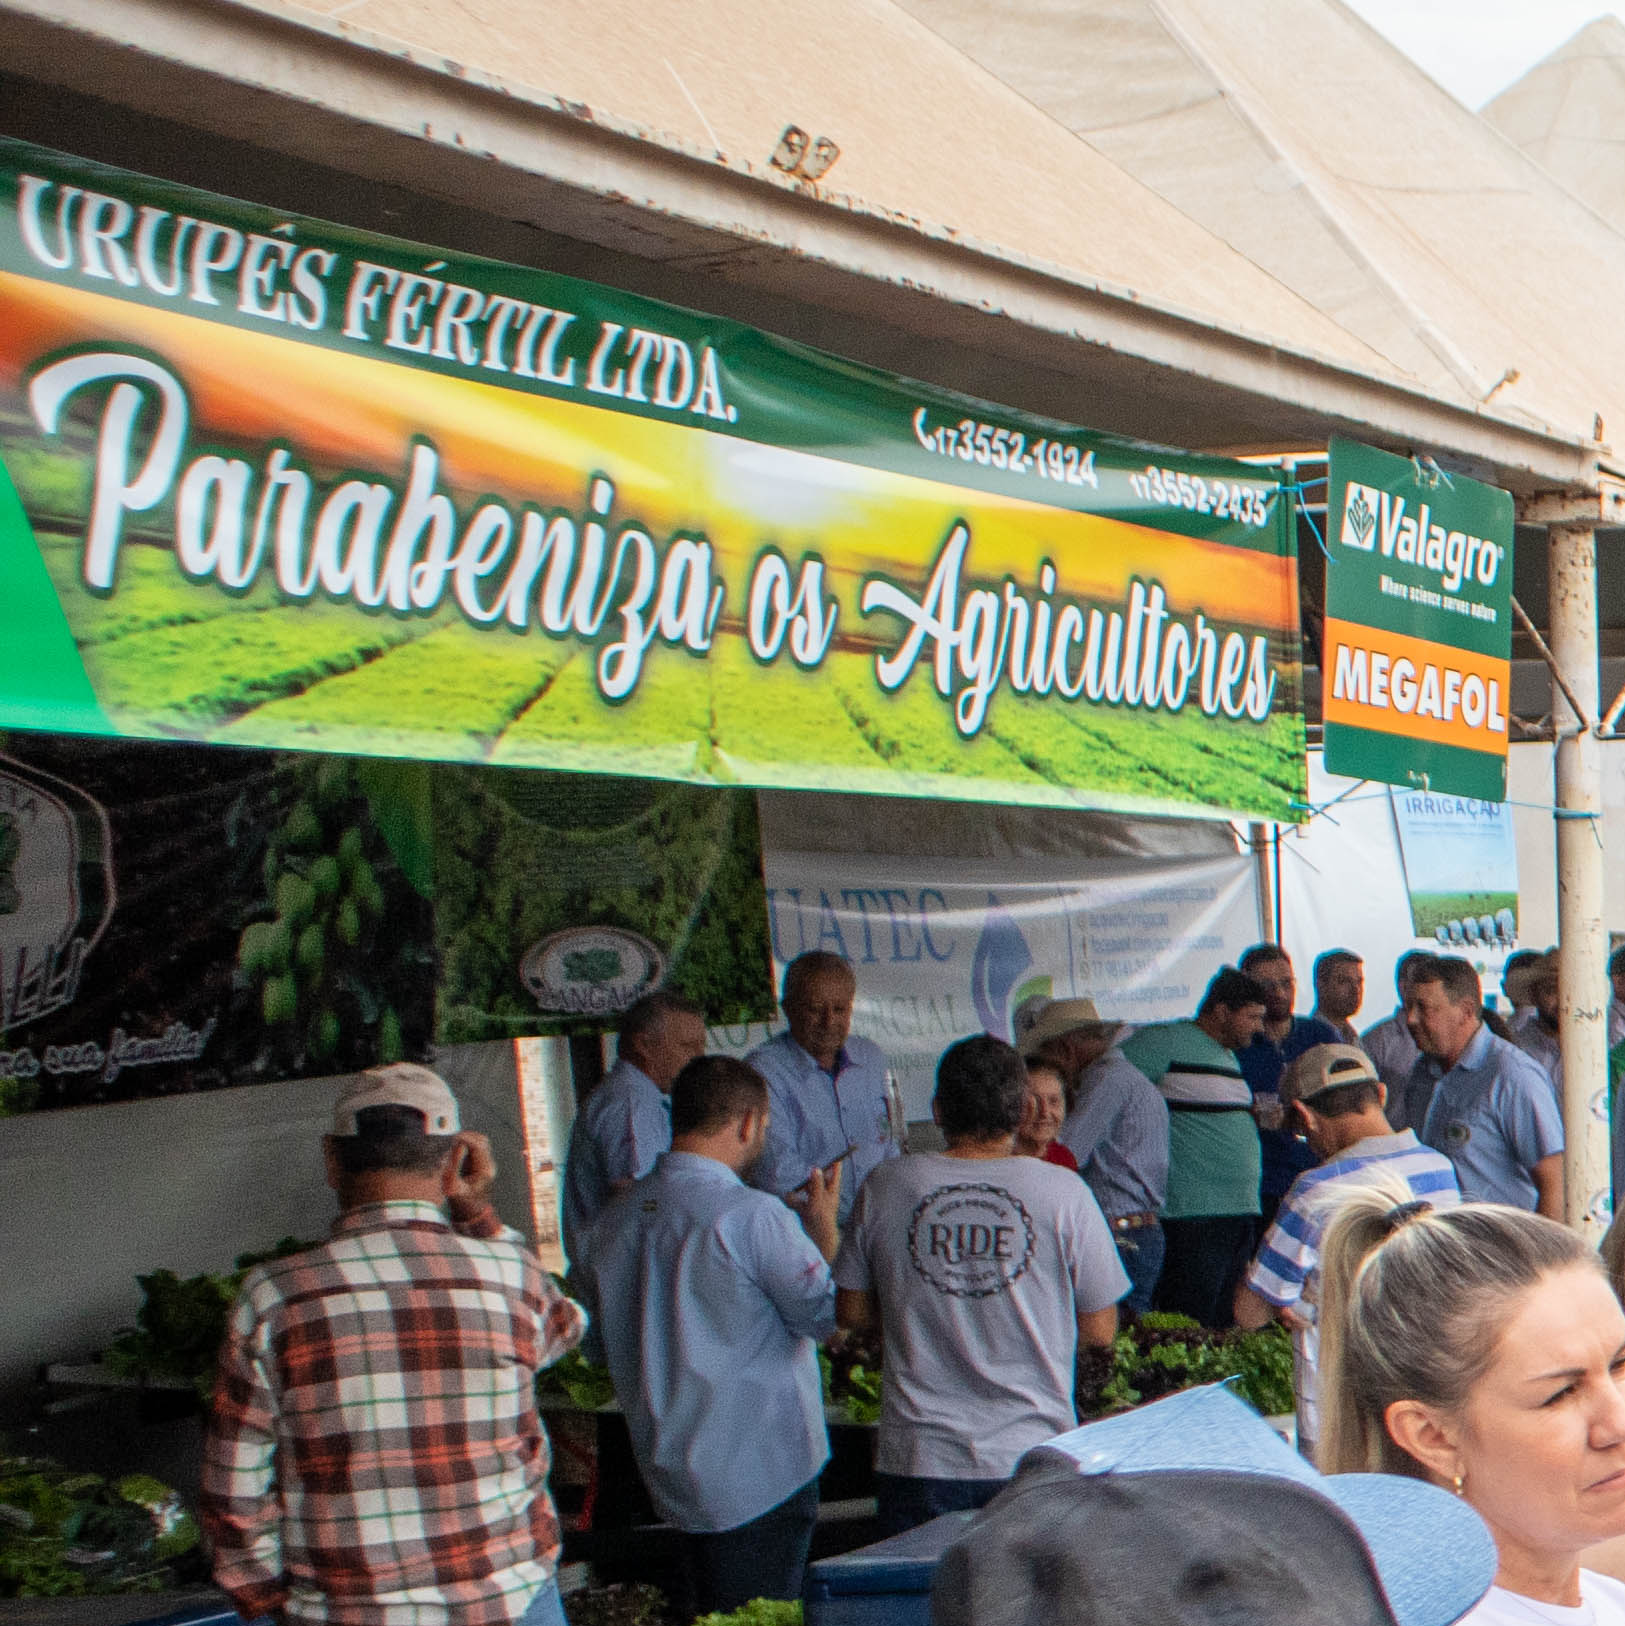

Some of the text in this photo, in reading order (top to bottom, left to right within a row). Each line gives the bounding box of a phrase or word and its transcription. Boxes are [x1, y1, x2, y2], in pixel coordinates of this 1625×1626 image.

[17, 174, 739, 424] URUPÊS FÉRTIL LTDA.
[30, 352, 1277, 736] Parabeniza os Agricultores
[1408, 584, 1441, 609] science
[1470, 599, 1497, 623] nature
[1332, 643, 1505, 732] MEGAFOL
[930, 1223, 1015, 1262] RIDE
